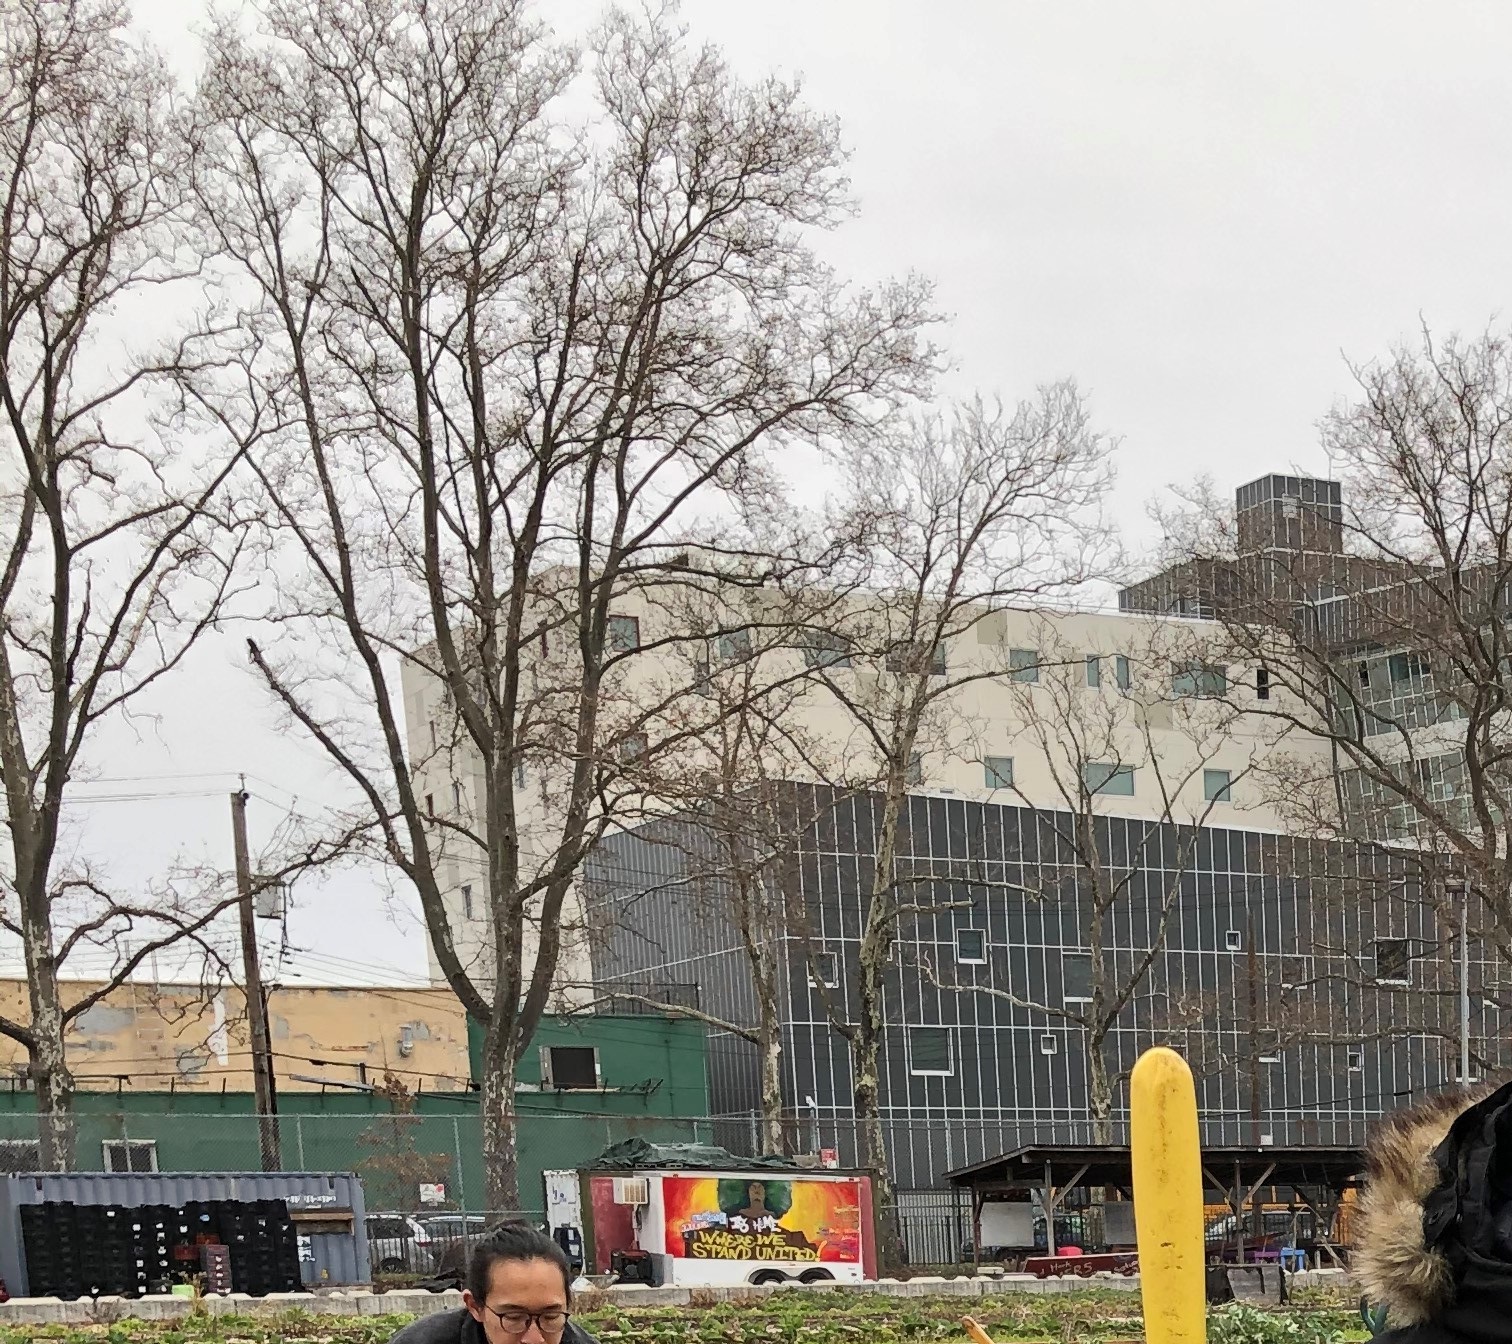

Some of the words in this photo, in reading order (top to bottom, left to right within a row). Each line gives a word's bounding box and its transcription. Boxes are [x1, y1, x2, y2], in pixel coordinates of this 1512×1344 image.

[699, 1230, 756, 1248] WHERE
[756, 1233, 786, 1246] WE
[692, 1242, 752, 1260] STAND
[755, 1240, 828, 1262] UNITED!
